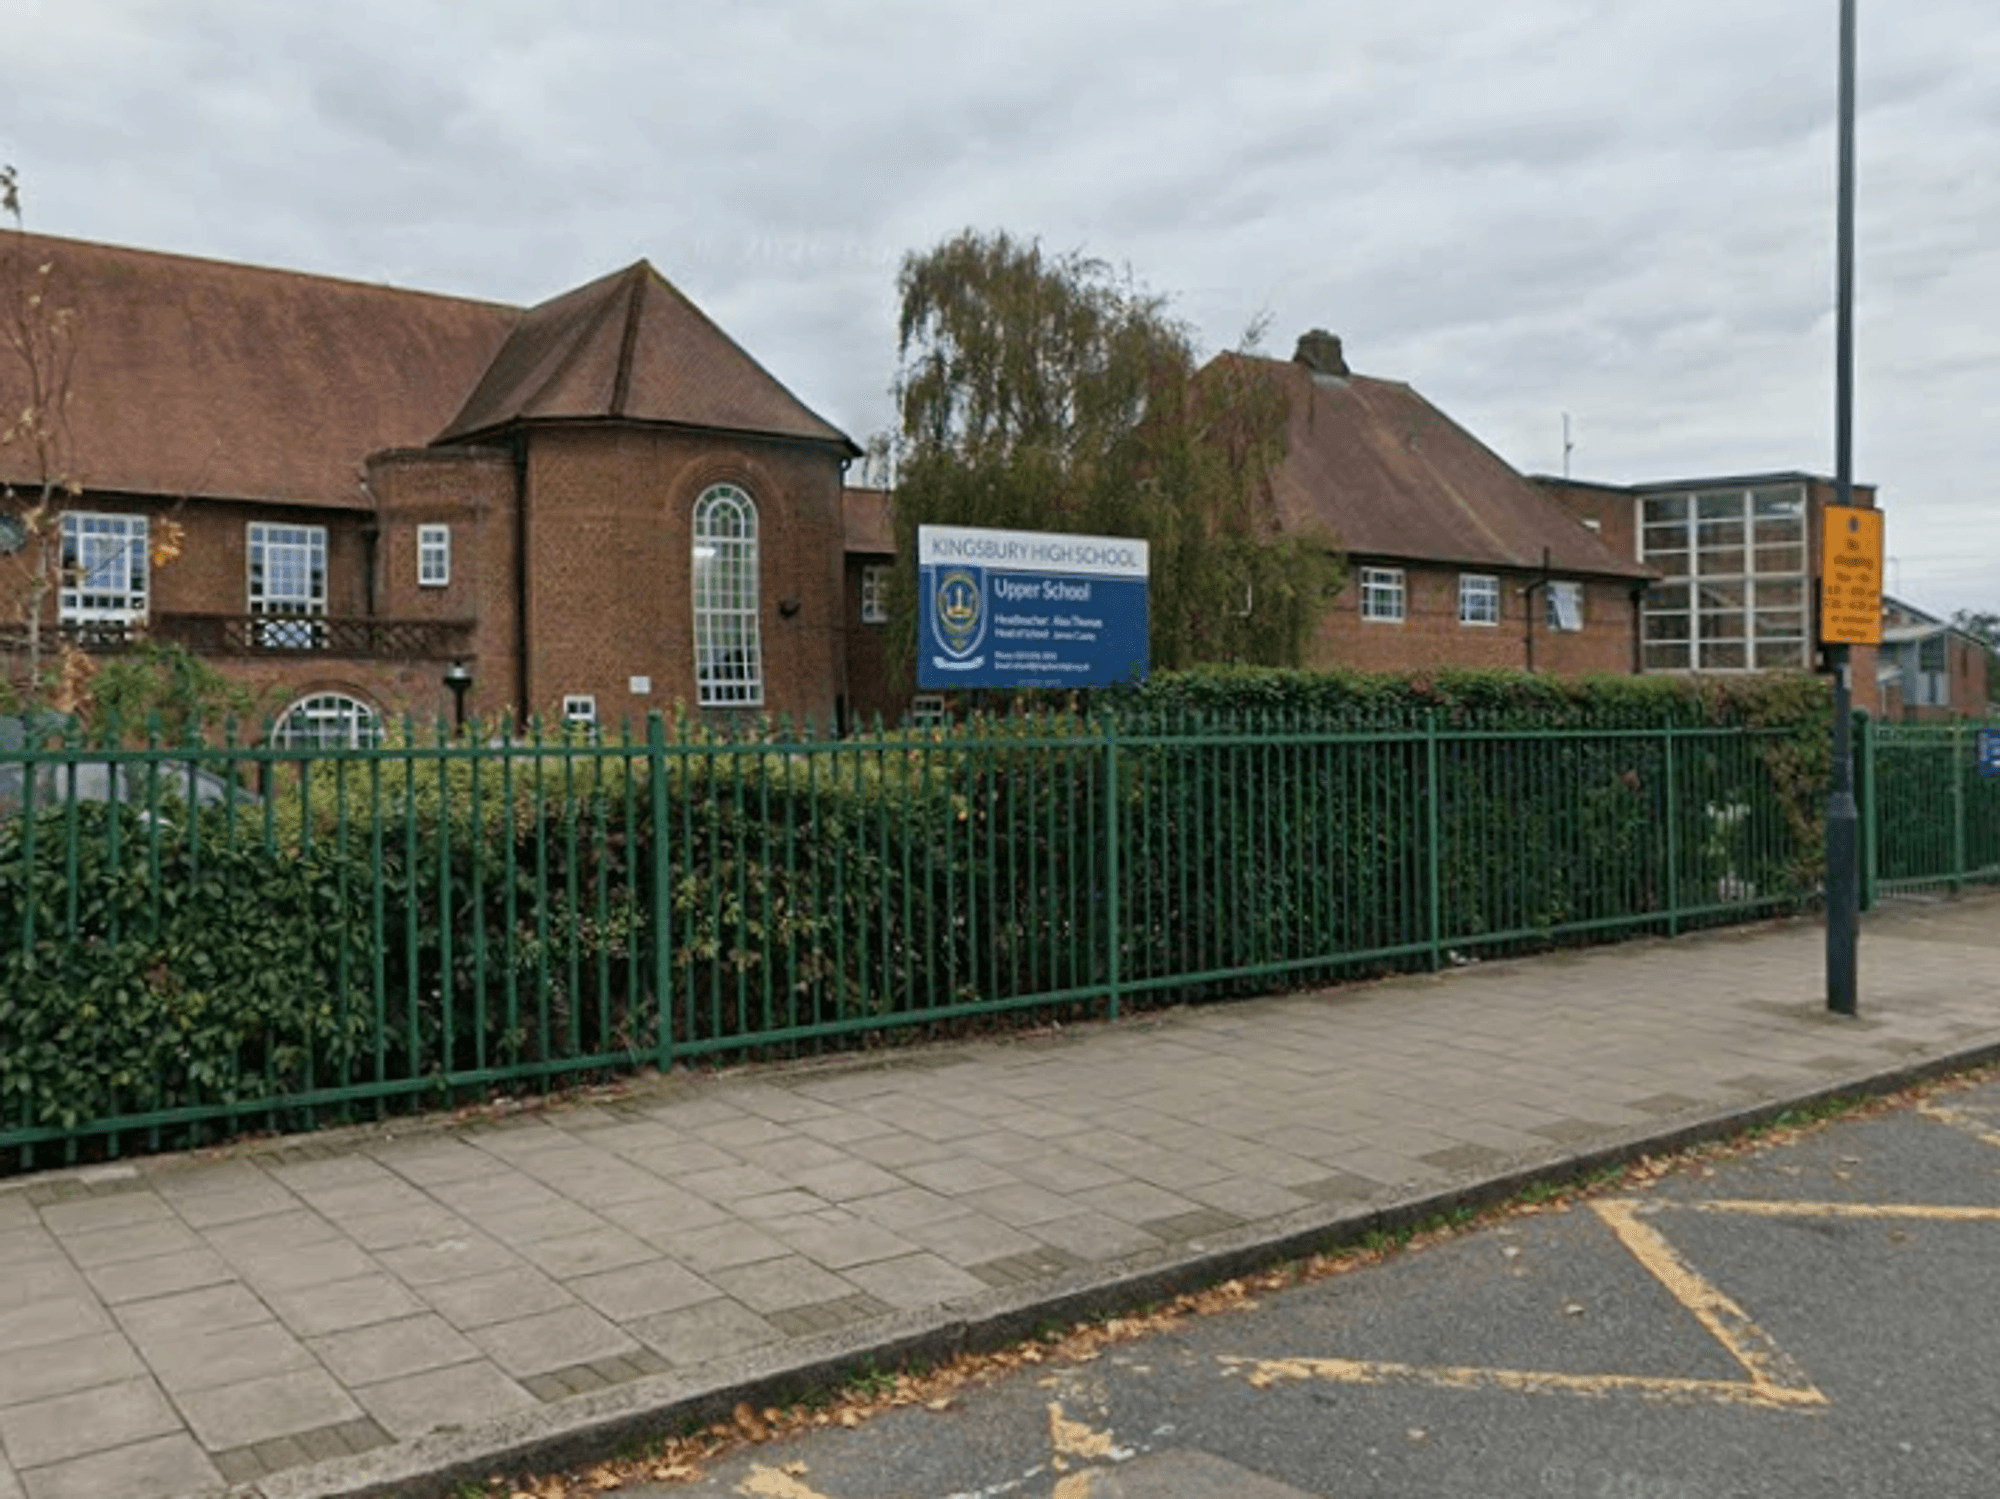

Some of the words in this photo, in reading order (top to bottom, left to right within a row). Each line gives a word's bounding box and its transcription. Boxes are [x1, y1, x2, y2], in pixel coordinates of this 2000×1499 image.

[932, 538, 1028, 560] KINGSBURY
[1032, 544, 1071, 562] HIGH
[1076, 546, 1138, 567] SCHOOL
[994, 578, 1039, 601] Upper
[1043, 580, 1091, 601] School
